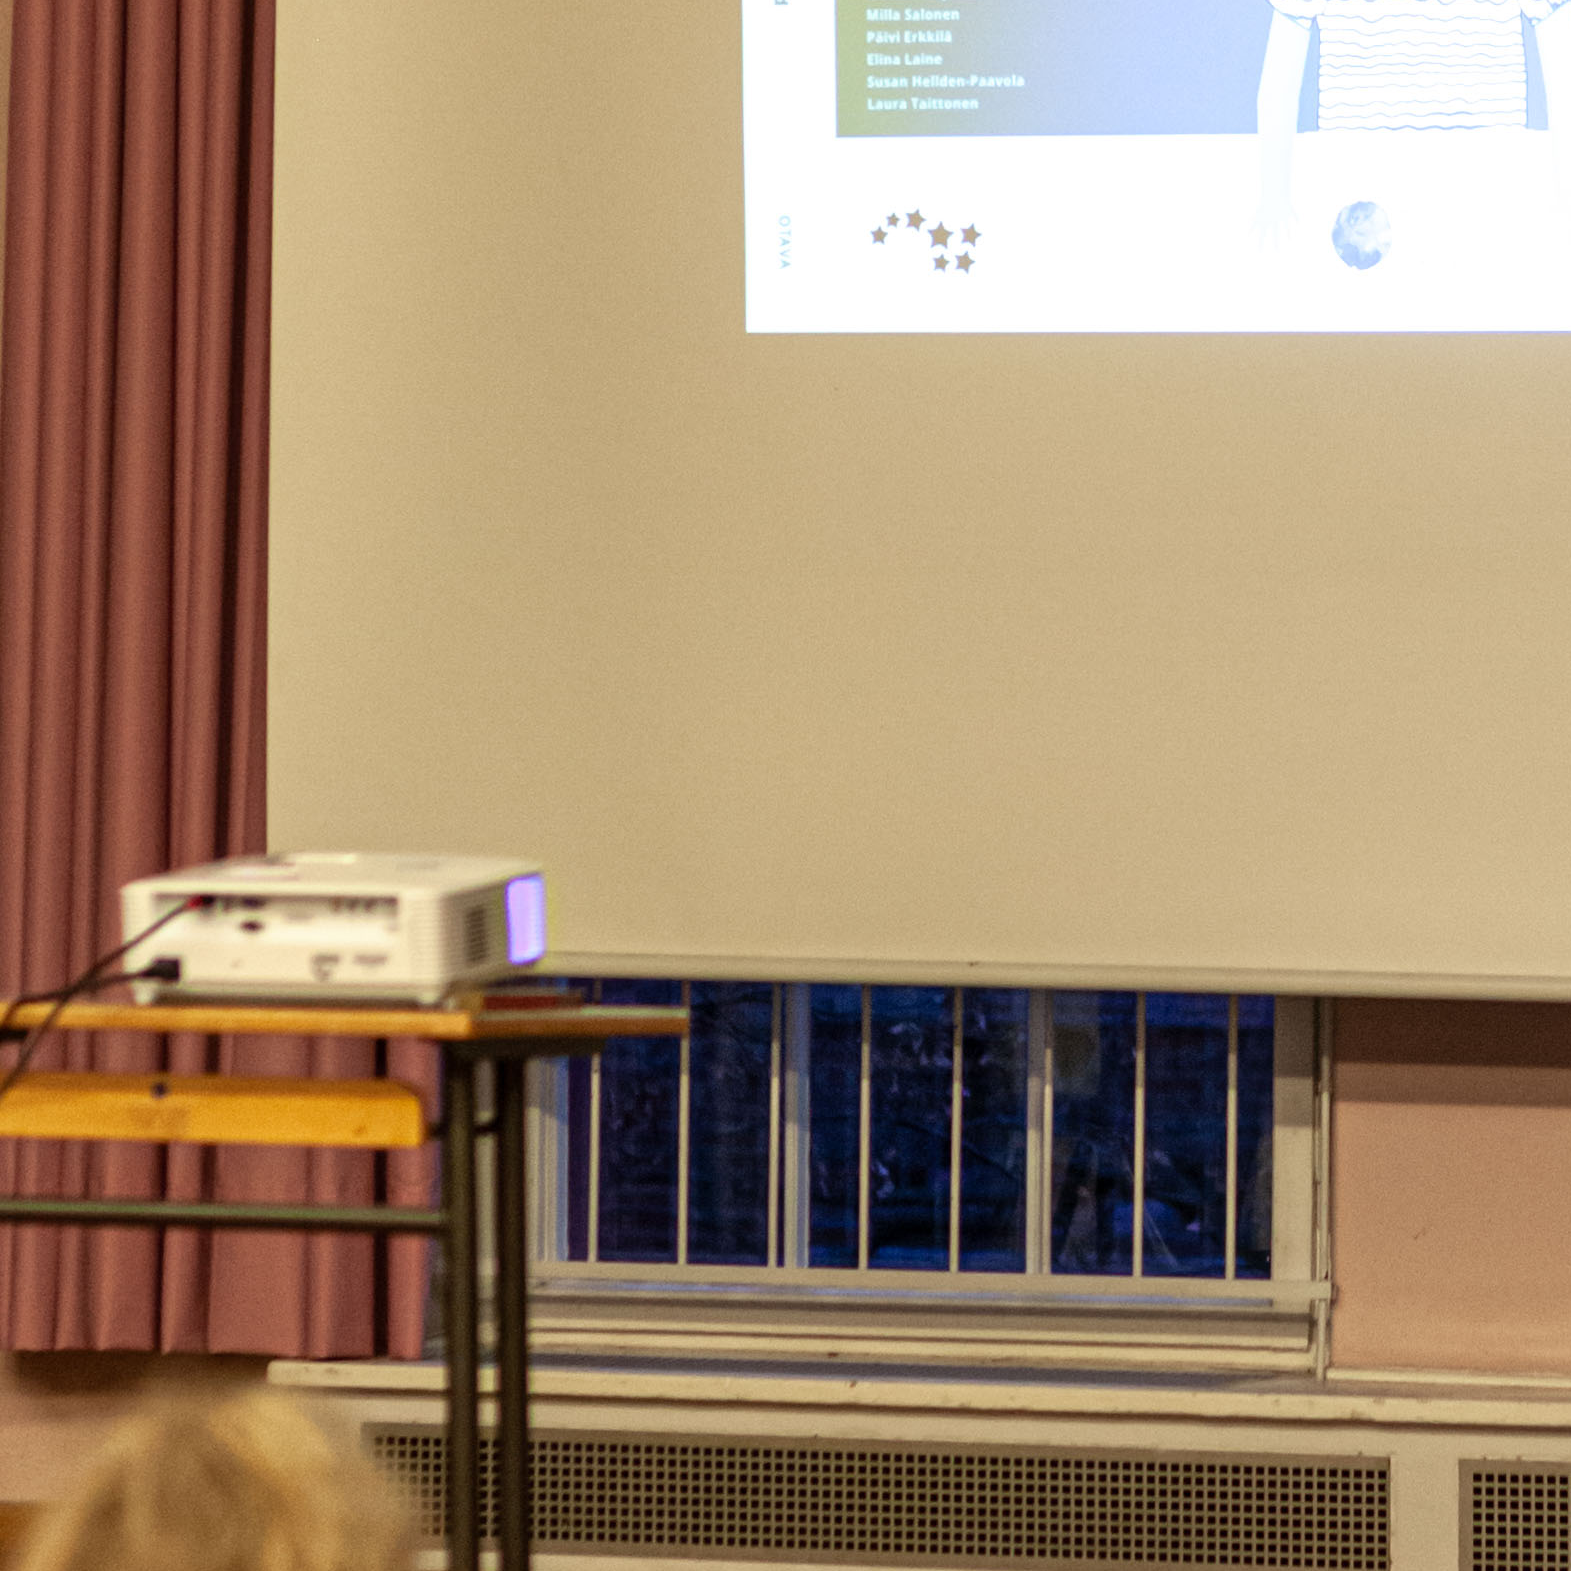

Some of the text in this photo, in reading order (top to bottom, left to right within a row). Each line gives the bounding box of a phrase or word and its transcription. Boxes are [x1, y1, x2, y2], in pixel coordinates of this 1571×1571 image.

[866, 8, 959, 20] Milla Salonen
[866, 31, 900, 43] Päivi
[866, 52, 942, 65] Elina Laine
[867, 75, 907, 88] Susan
[867, 96, 978, 110] Laura Taittonen
[778, 214, 792, 269] OTAVA
